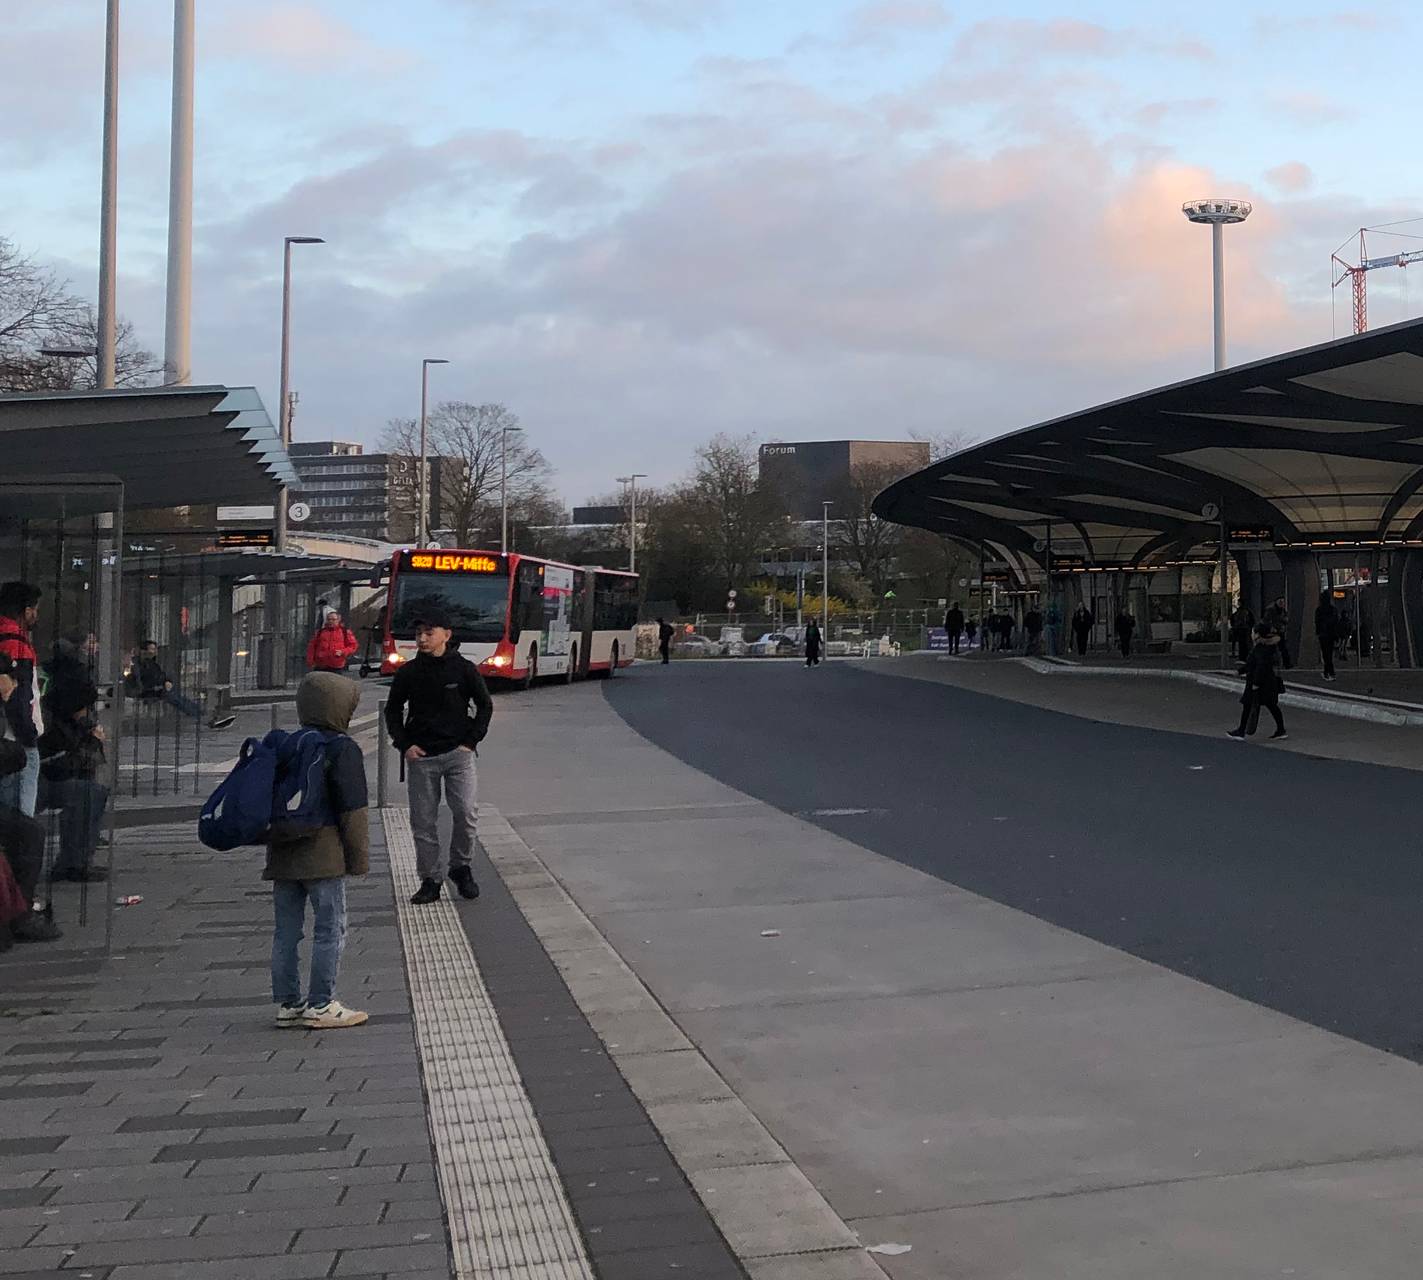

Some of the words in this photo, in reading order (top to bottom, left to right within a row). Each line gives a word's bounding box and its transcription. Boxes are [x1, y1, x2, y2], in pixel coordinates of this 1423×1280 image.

[763, 445, 796, 455] Forum
[294, 506, 304, 518] 3
[1207, 505, 1215, 516] 7
[435, 556, 497, 571] LEV-Mitte
